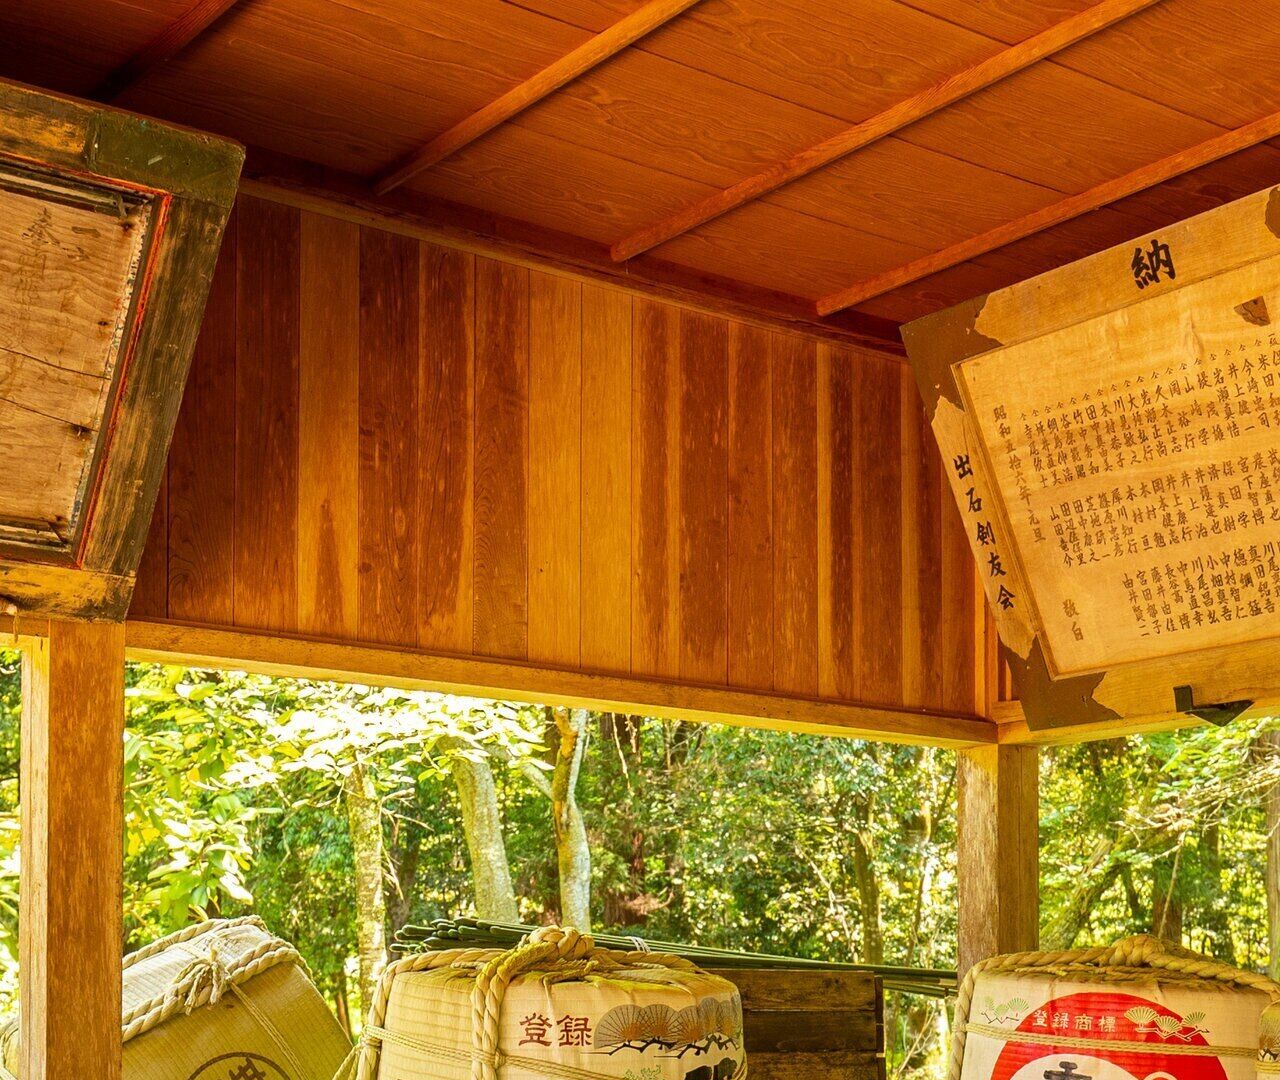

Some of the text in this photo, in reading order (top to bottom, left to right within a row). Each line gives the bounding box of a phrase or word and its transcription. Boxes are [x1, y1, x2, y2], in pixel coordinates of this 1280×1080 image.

[1130, 238, 1176, 291] 納
[953, 455, 1018, 611] 出石剣友会
[518, 1011, 593, 1048] 登録
[1031, 1009, 1117, 1034] 登録商標
